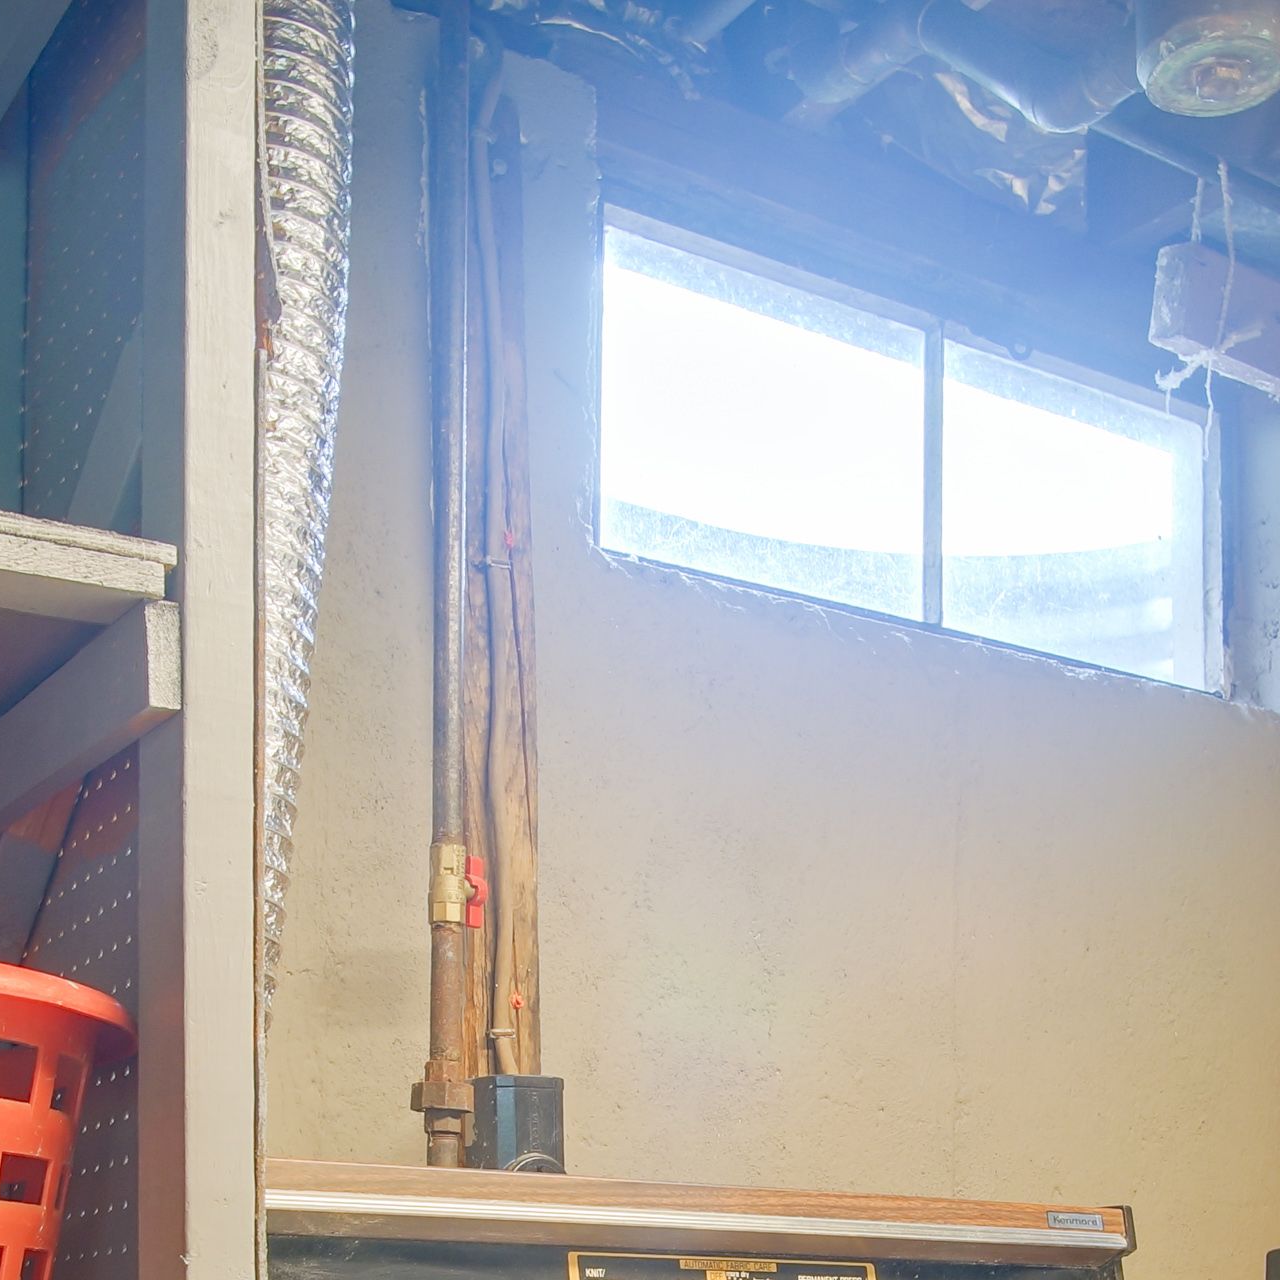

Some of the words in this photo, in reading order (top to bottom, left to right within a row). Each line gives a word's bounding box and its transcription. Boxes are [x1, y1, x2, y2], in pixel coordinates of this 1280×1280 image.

[684, 1260, 722, 1269] AUTOMATIC
[726, 1261, 750, 1270] FABRIC
[753, 1262, 773, 1271] CARE
[585, 1268, 605, 1278] KNIT/
[710, 1271, 725, 1279] OFF
[740, 1271, 750, 1279] dry
